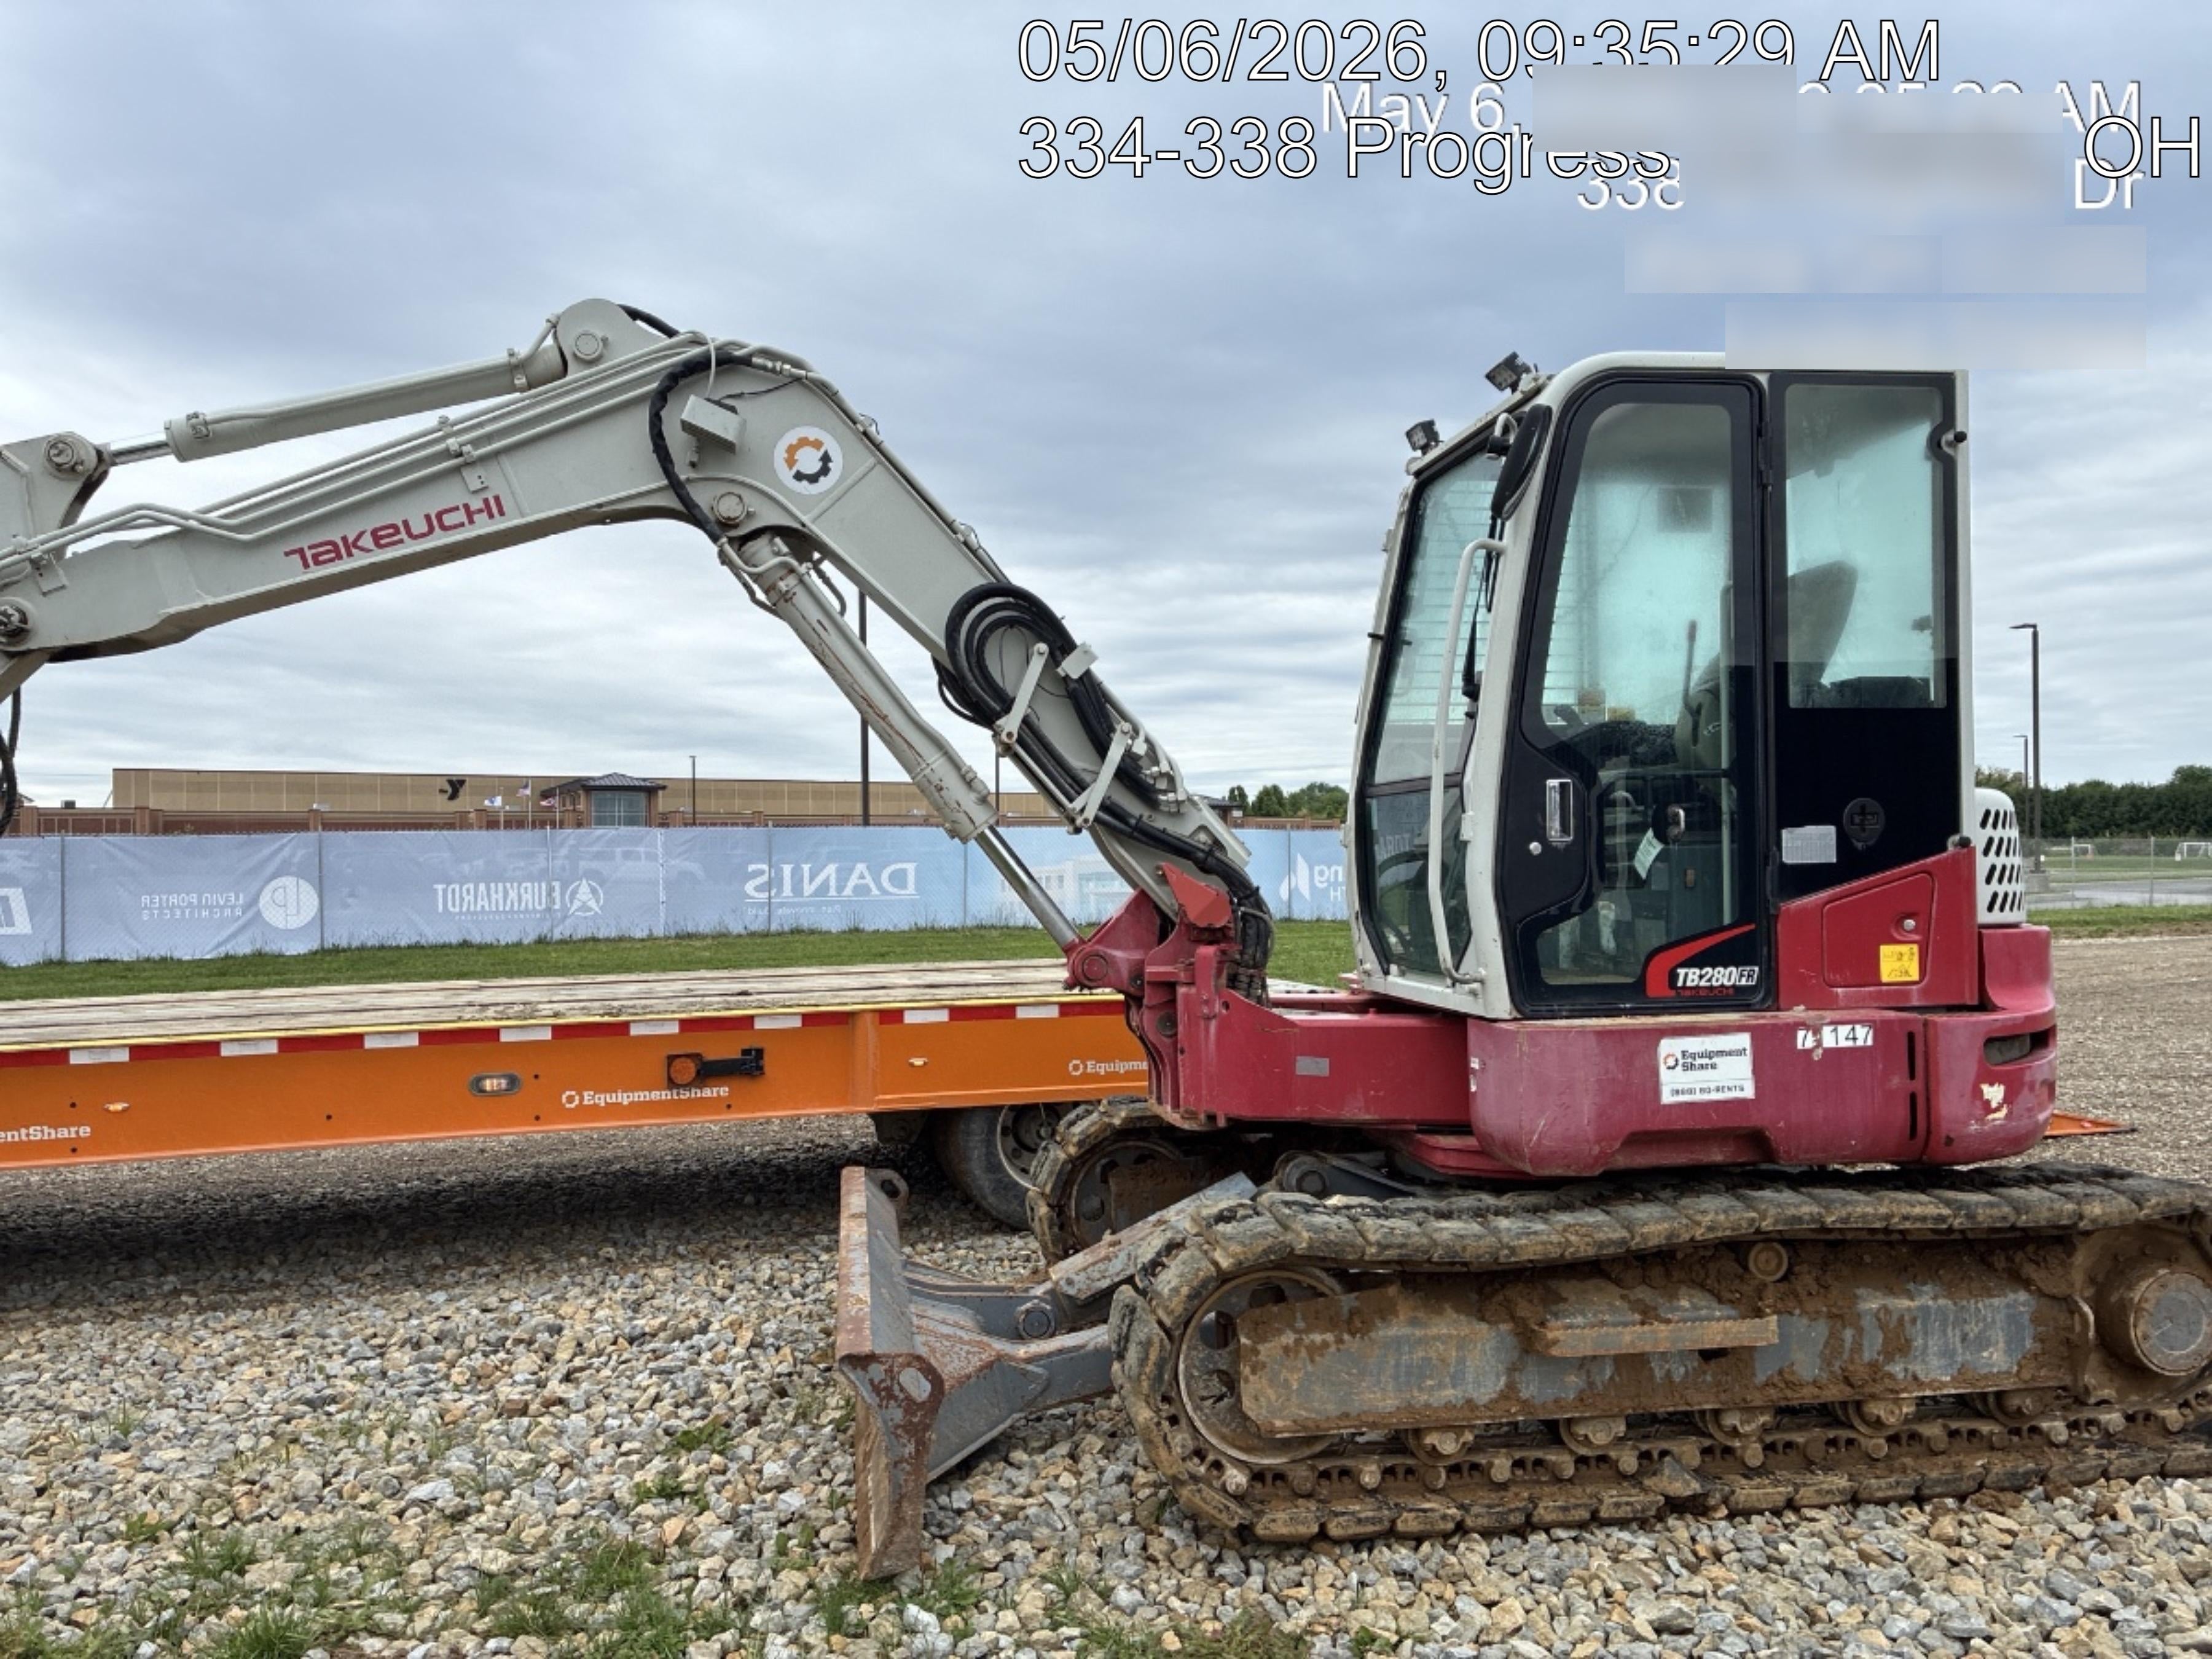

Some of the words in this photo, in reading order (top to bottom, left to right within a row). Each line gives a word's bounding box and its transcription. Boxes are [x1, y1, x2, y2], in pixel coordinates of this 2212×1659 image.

[1681, 1047, 1747, 1061] Equipment
[1681, 1061, 1717, 1072] Share
[582, 1085, 729, 1107] EquipmentShare
